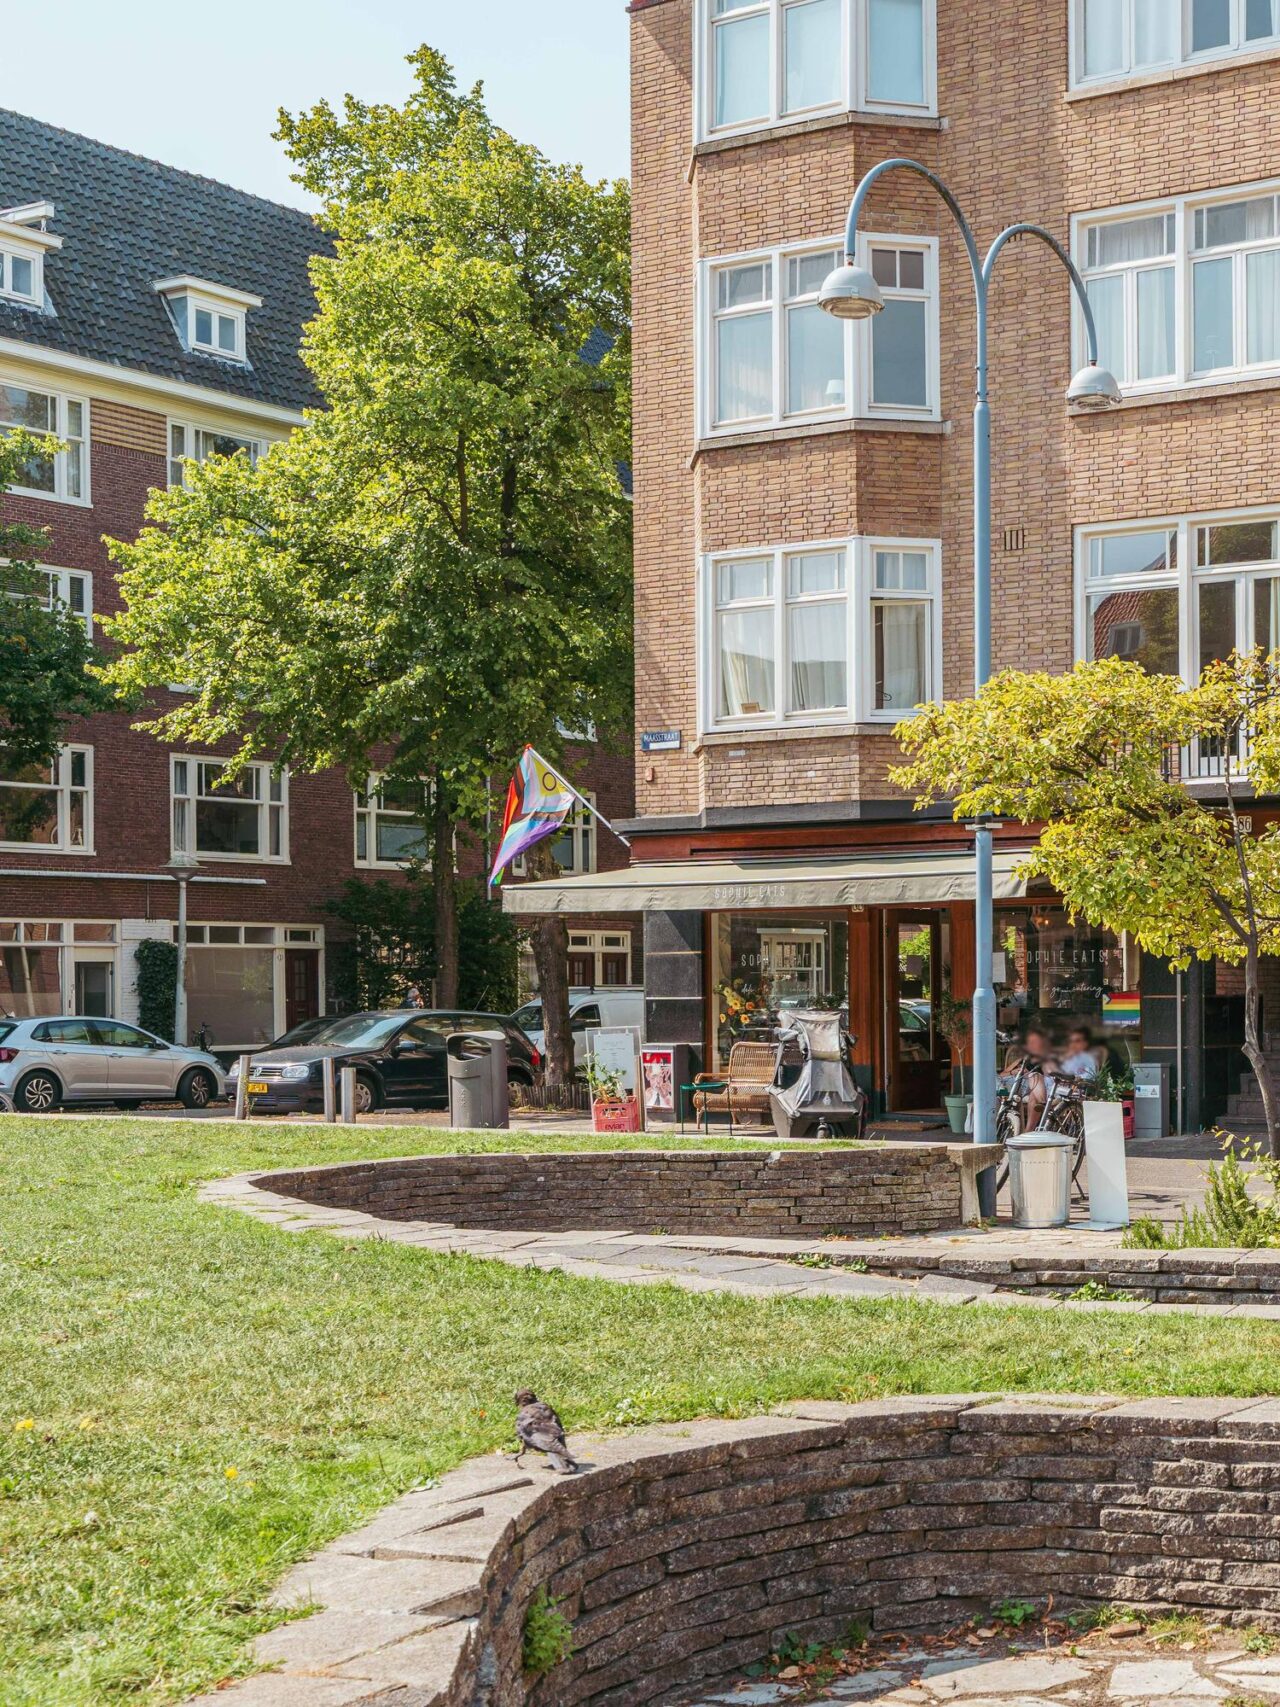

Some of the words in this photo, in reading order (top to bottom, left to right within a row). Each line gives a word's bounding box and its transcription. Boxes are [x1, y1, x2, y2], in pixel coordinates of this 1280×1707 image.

[643, 731, 678, 742] MAASSTRAAT
[1238, 817, 1251, 831] 86
[714, 886, 753, 899] SOPHIE
[758, 885, 786, 898] EATS
[741, 953, 782, 967] SOPH
[1023, 949, 1065, 964] OPHIE
[1072, 949, 1105, 963] EATS
[1071, 982, 1104, 999] catering
[604, 1123, 625, 1131] evian
